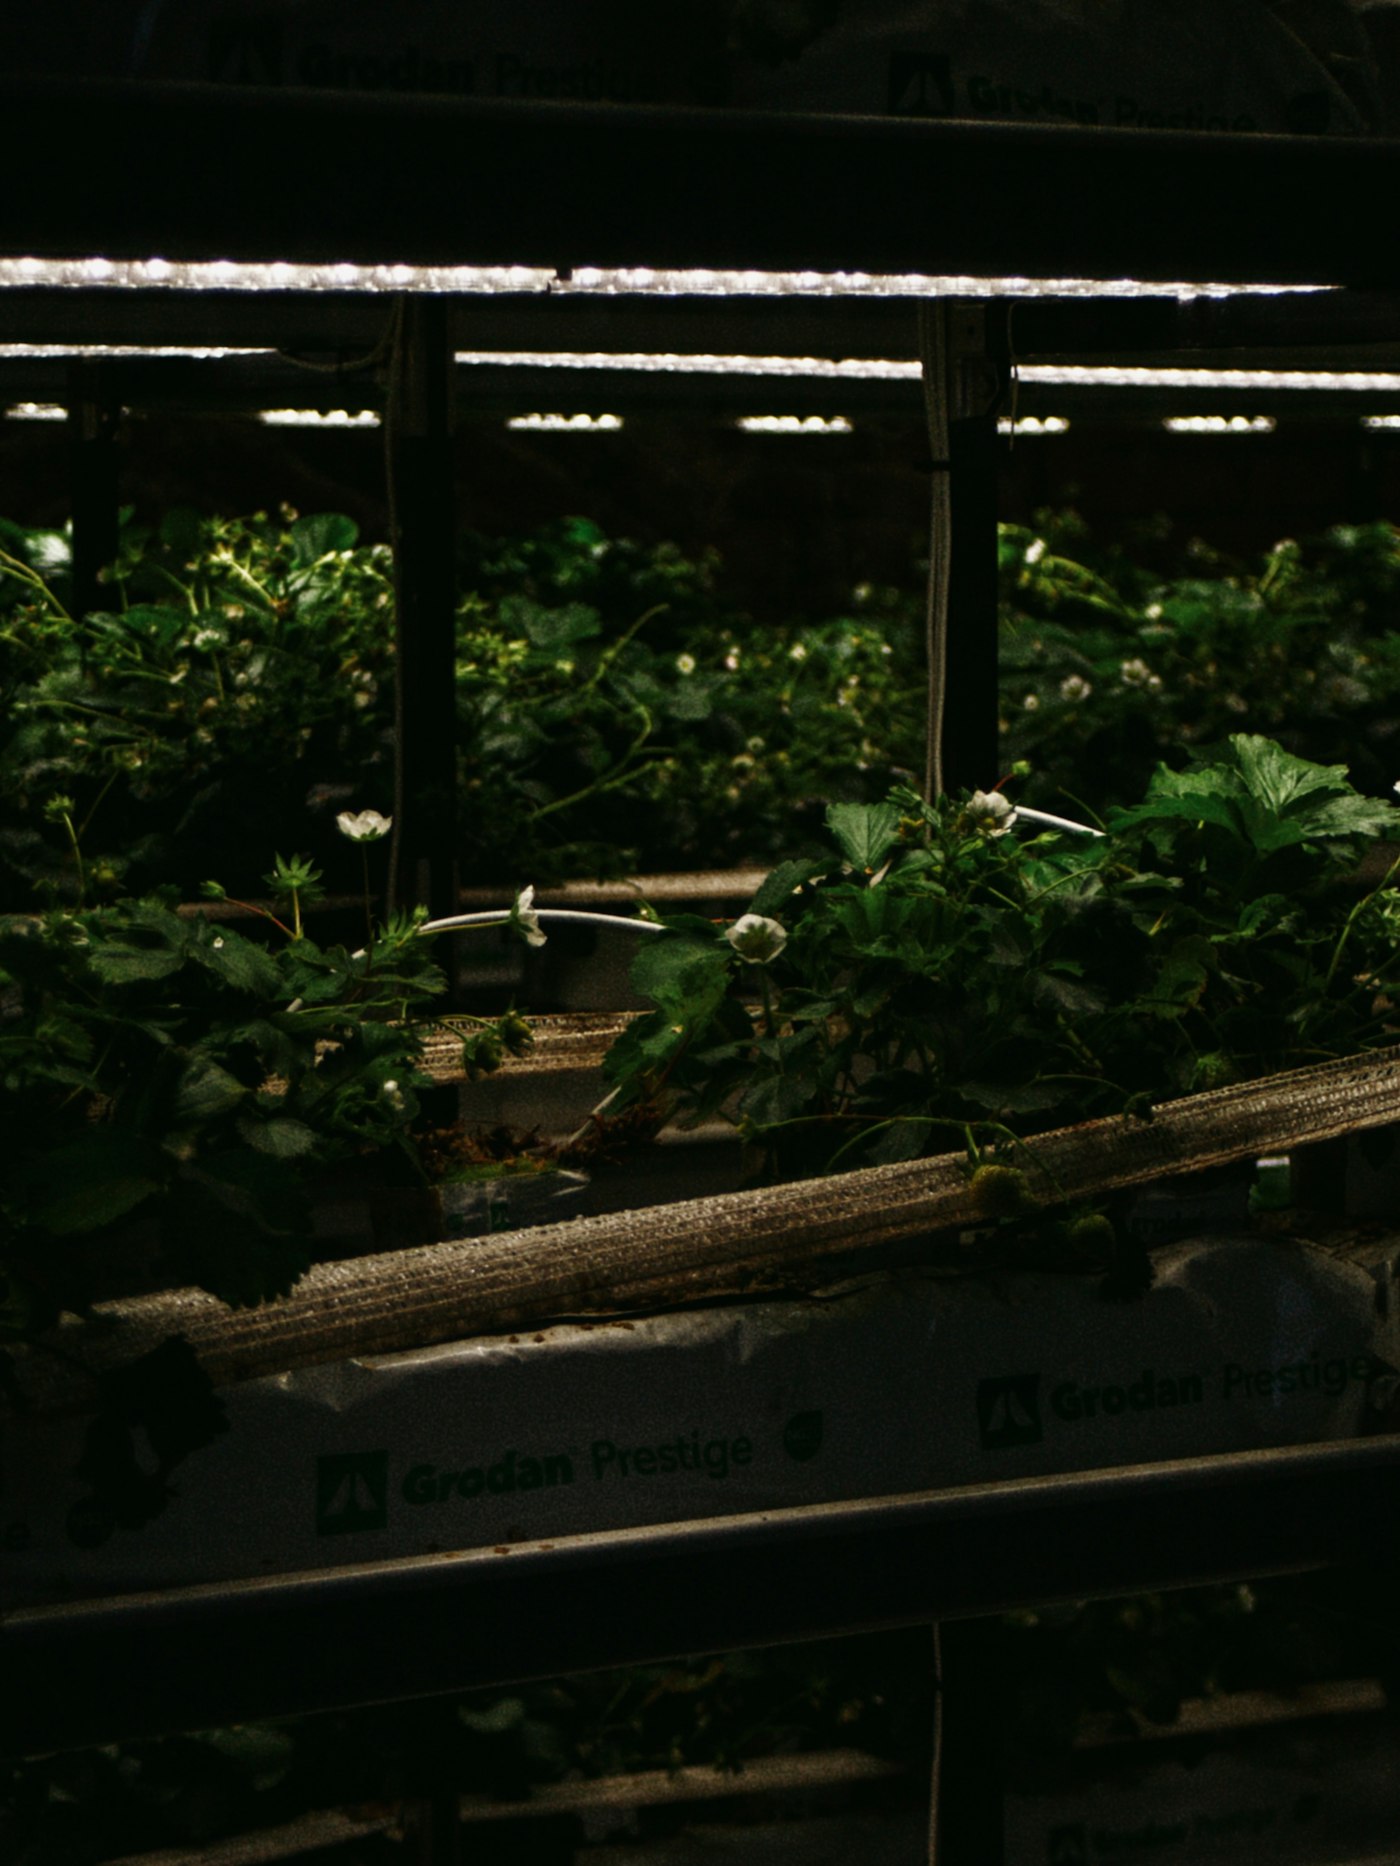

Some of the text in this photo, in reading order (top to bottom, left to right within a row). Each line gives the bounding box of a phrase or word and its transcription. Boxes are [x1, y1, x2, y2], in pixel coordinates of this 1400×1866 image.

[1050, 1351, 1372, 1422] Grodan Prestige
[401, 1429, 753, 1505] Grodan Prestige
